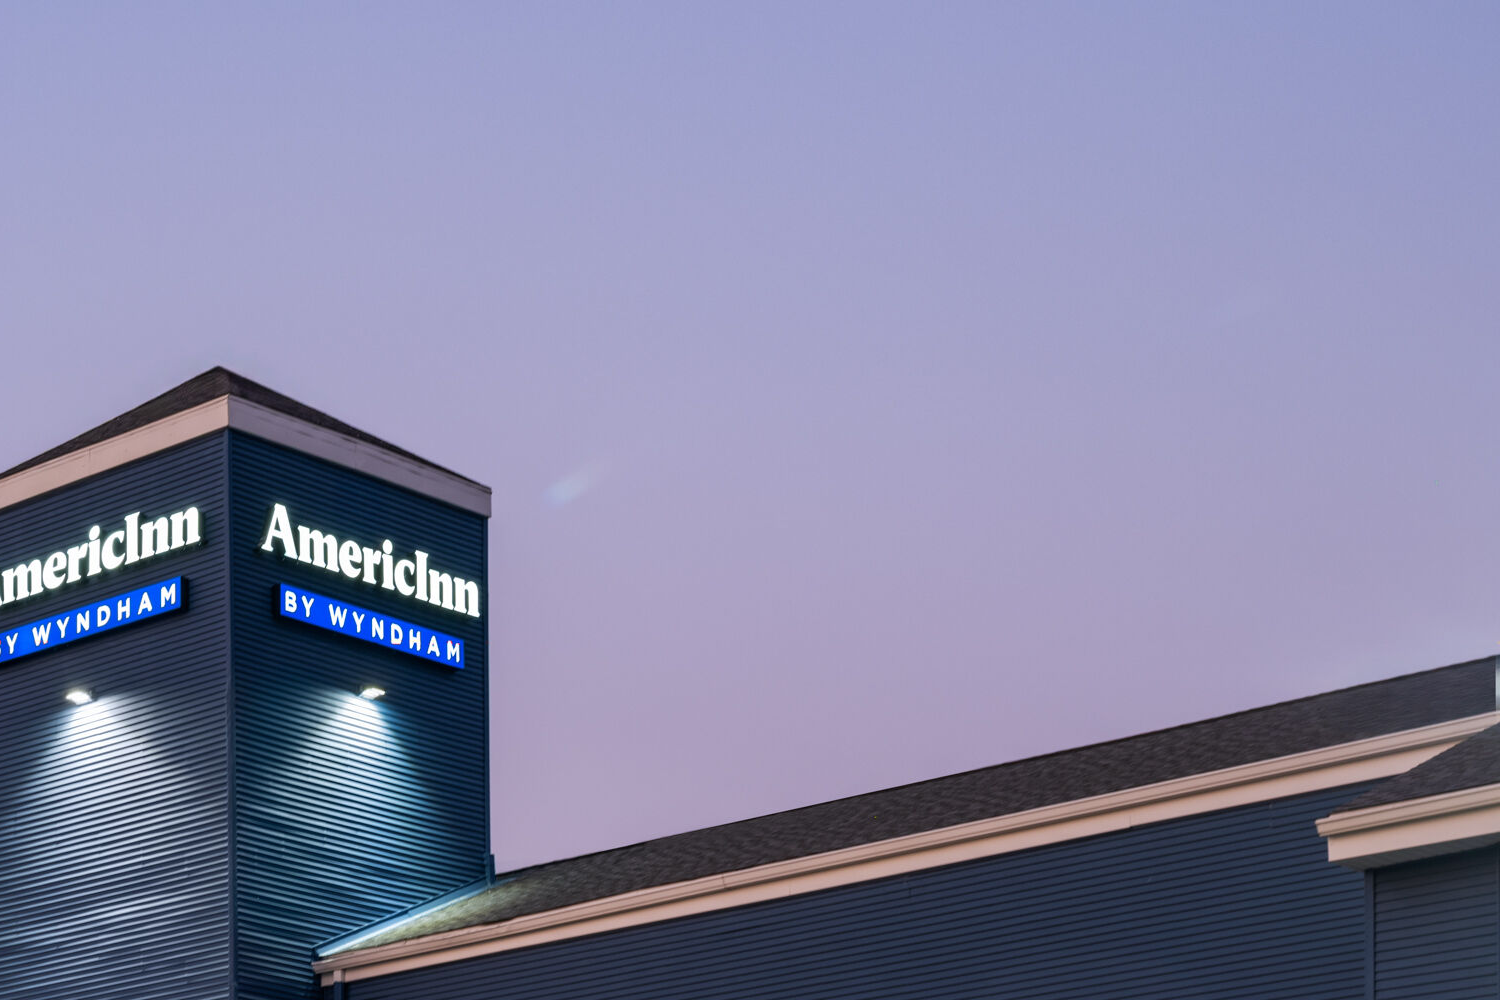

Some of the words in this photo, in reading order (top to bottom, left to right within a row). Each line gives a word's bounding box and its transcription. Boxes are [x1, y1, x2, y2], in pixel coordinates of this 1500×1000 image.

[260, 502, 481, 618] AmericInn
[32, 583, 177, 647] WYNDHAM
[285, 590, 315, 618] BY
[328, 603, 461, 664] WYNDHAM
